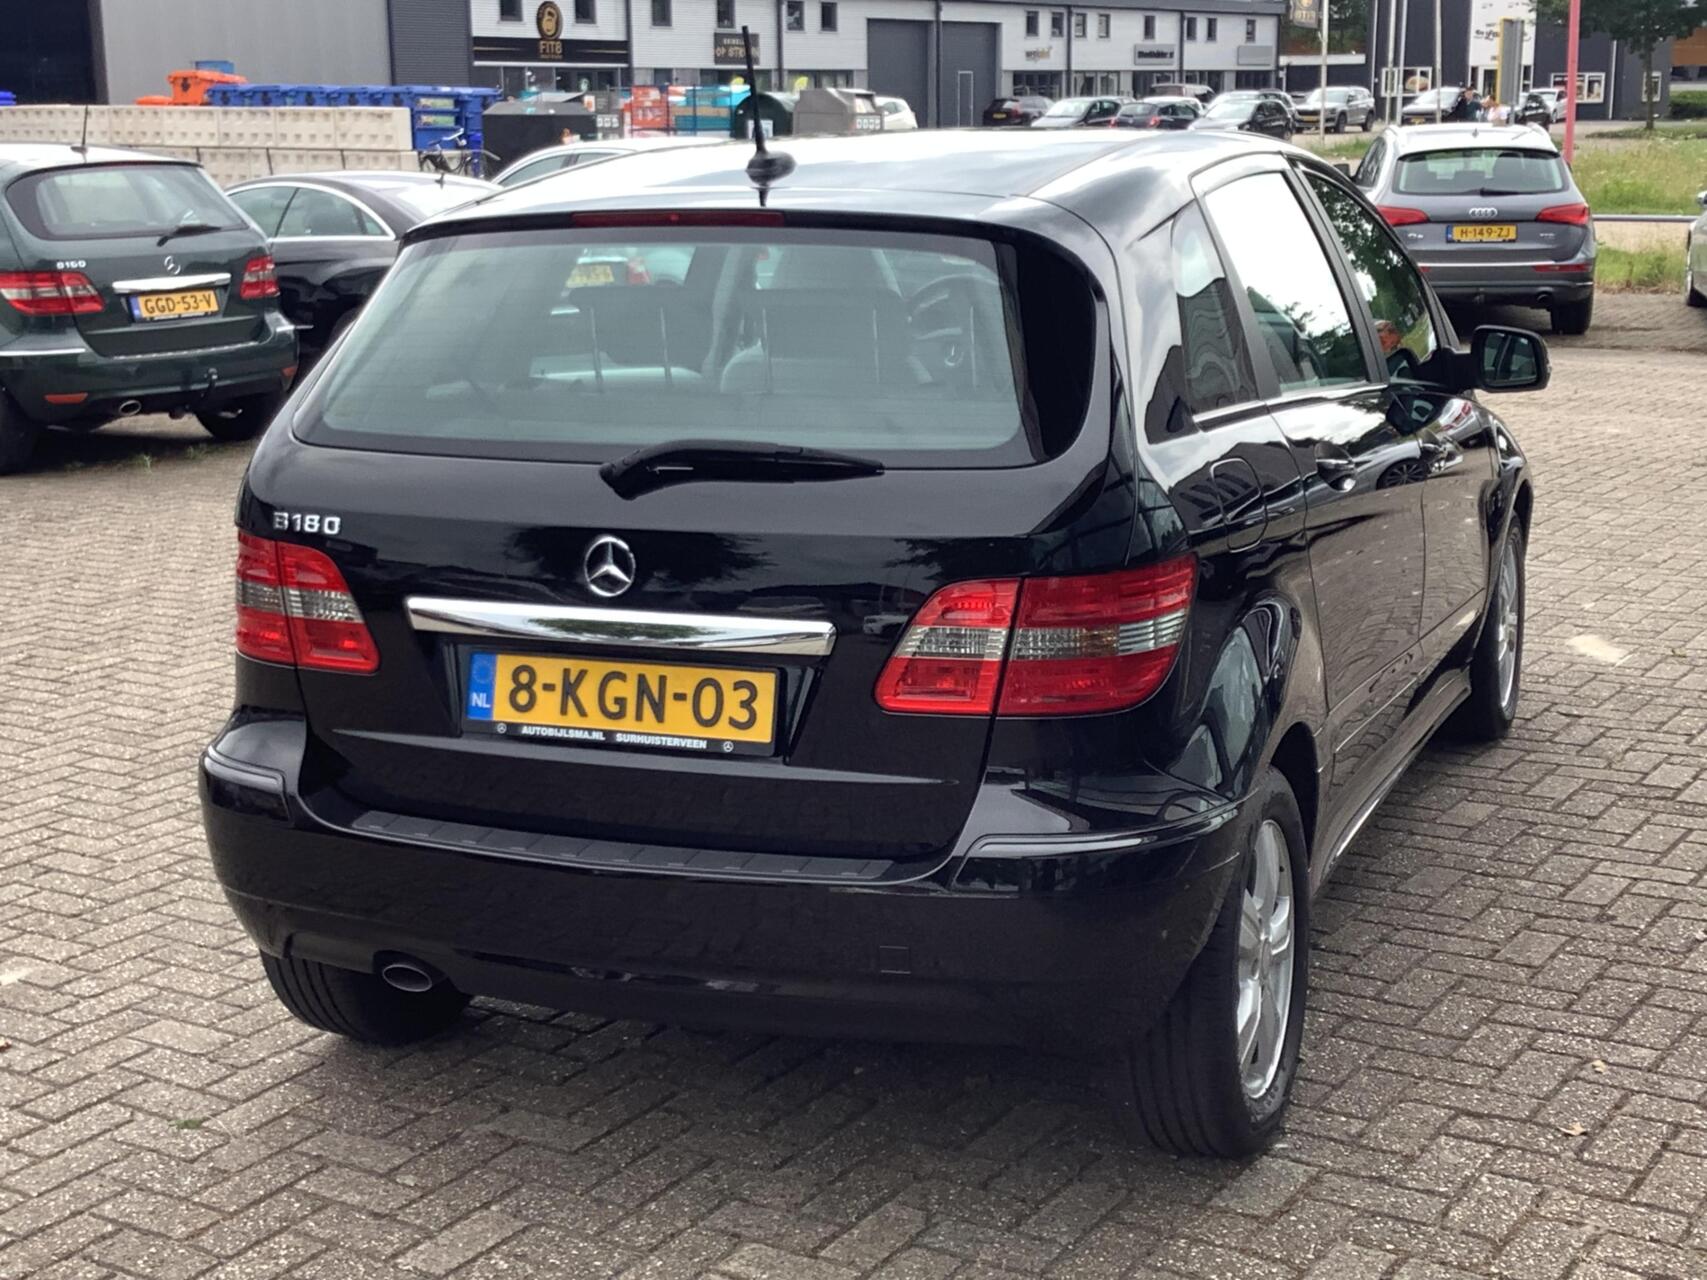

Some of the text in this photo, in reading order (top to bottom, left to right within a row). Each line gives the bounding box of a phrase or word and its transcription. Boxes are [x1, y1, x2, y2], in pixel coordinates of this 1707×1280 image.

[1460, 227, 1511, 238] H-149-ZJ
[144, 293, 213, 315] GGD-53-V
[273, 511, 341, 534] B180
[471, 692, 491, 708] NL
[509, 664, 759, 731] 8-KGN-03
[521, 725, 707, 749] AUTOBIJLSMA.NL SURHUISTERVEEN
